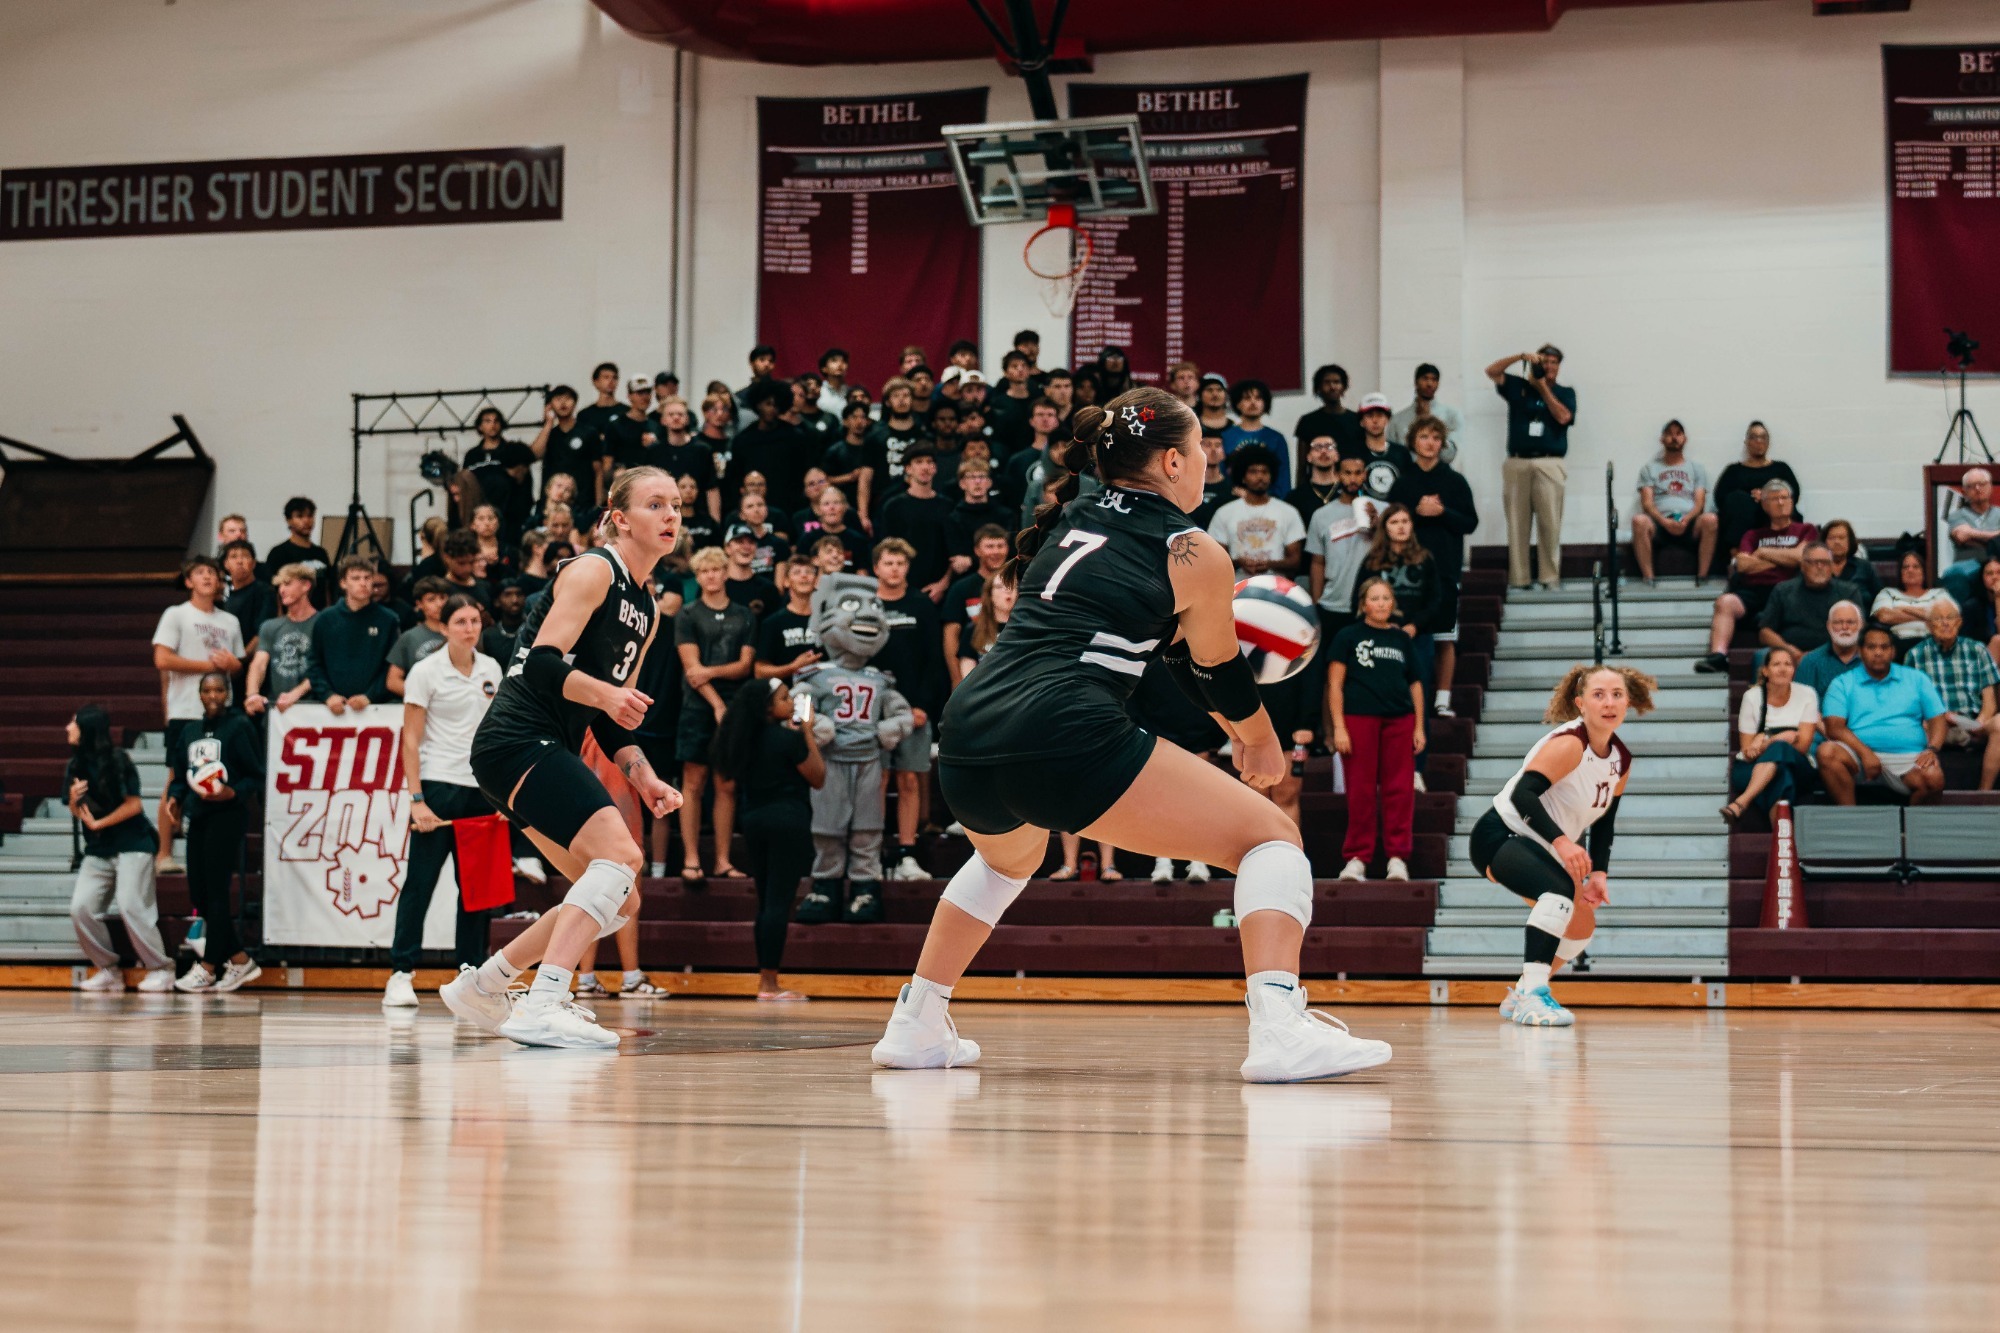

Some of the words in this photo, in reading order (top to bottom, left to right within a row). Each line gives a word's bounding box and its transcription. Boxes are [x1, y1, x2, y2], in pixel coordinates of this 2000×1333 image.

[1958, 51, 2000, 74] BE
[823, 101, 921, 124] BETHEL
[1137, 88, 1240, 113] BETHEL
[5, 174, 195, 228] THRESHER
[206, 167, 383, 222] STUDENT
[394, 159, 559, 215] SECTION
[1040, 528, 1109, 601] 7
[611, 640, 638, 682] 3
[832, 682, 877, 724] 37
[276, 726, 408, 794] STO
